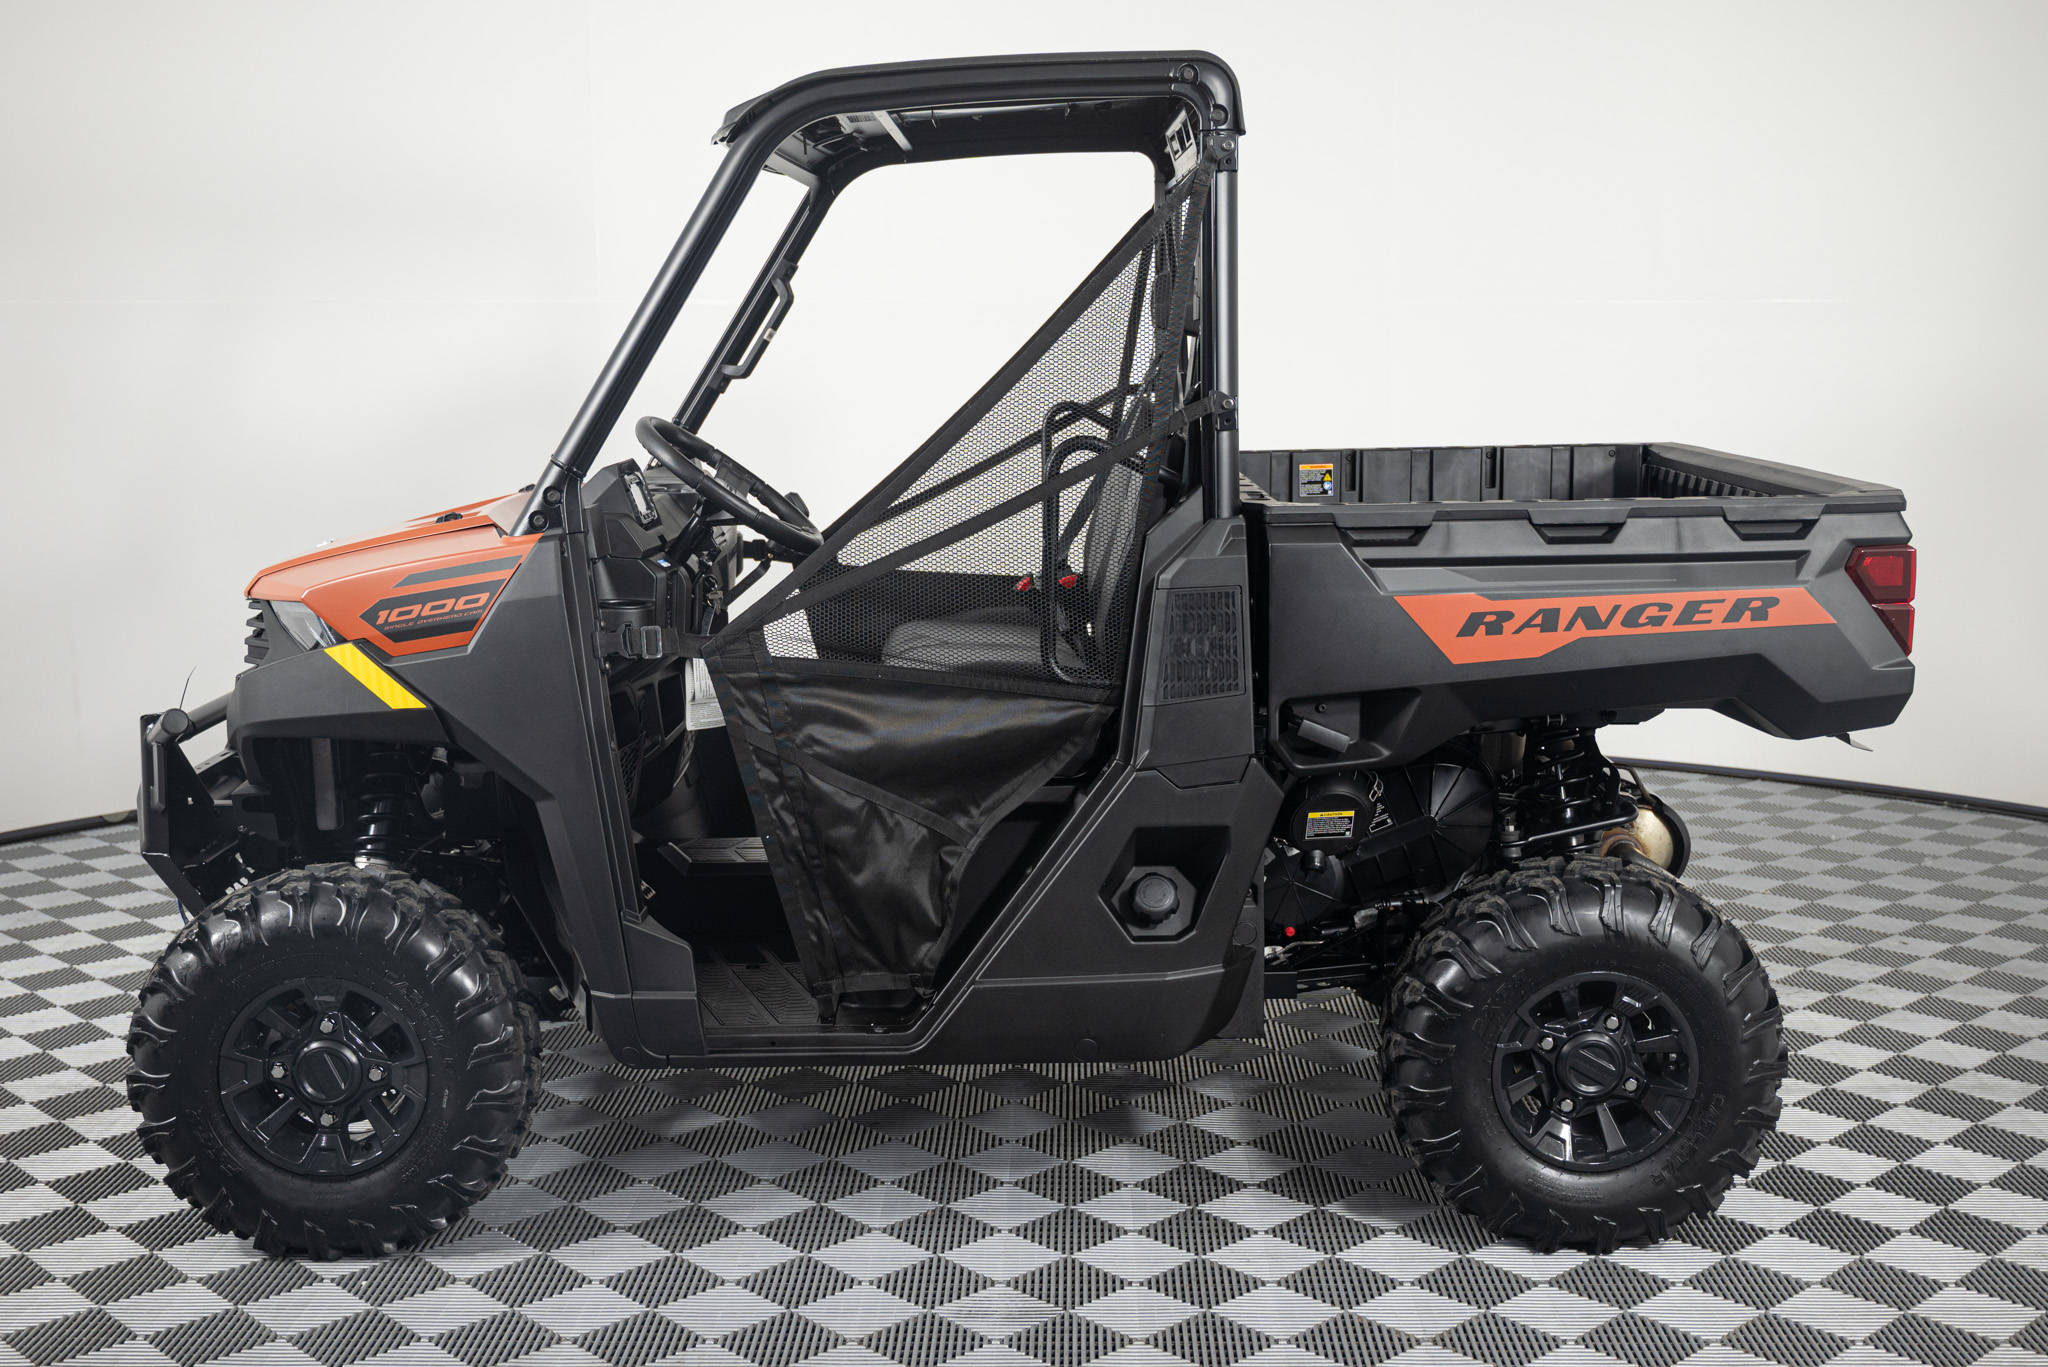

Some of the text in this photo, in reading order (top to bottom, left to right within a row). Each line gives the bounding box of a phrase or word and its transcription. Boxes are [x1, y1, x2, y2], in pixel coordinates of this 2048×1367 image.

[376, 592, 490, 625] 1000
[384, 621, 414, 630] SINGLE
[417, 612, 462, 624] OVERHEAD
[1455, 596, 1781, 637] RANGER
